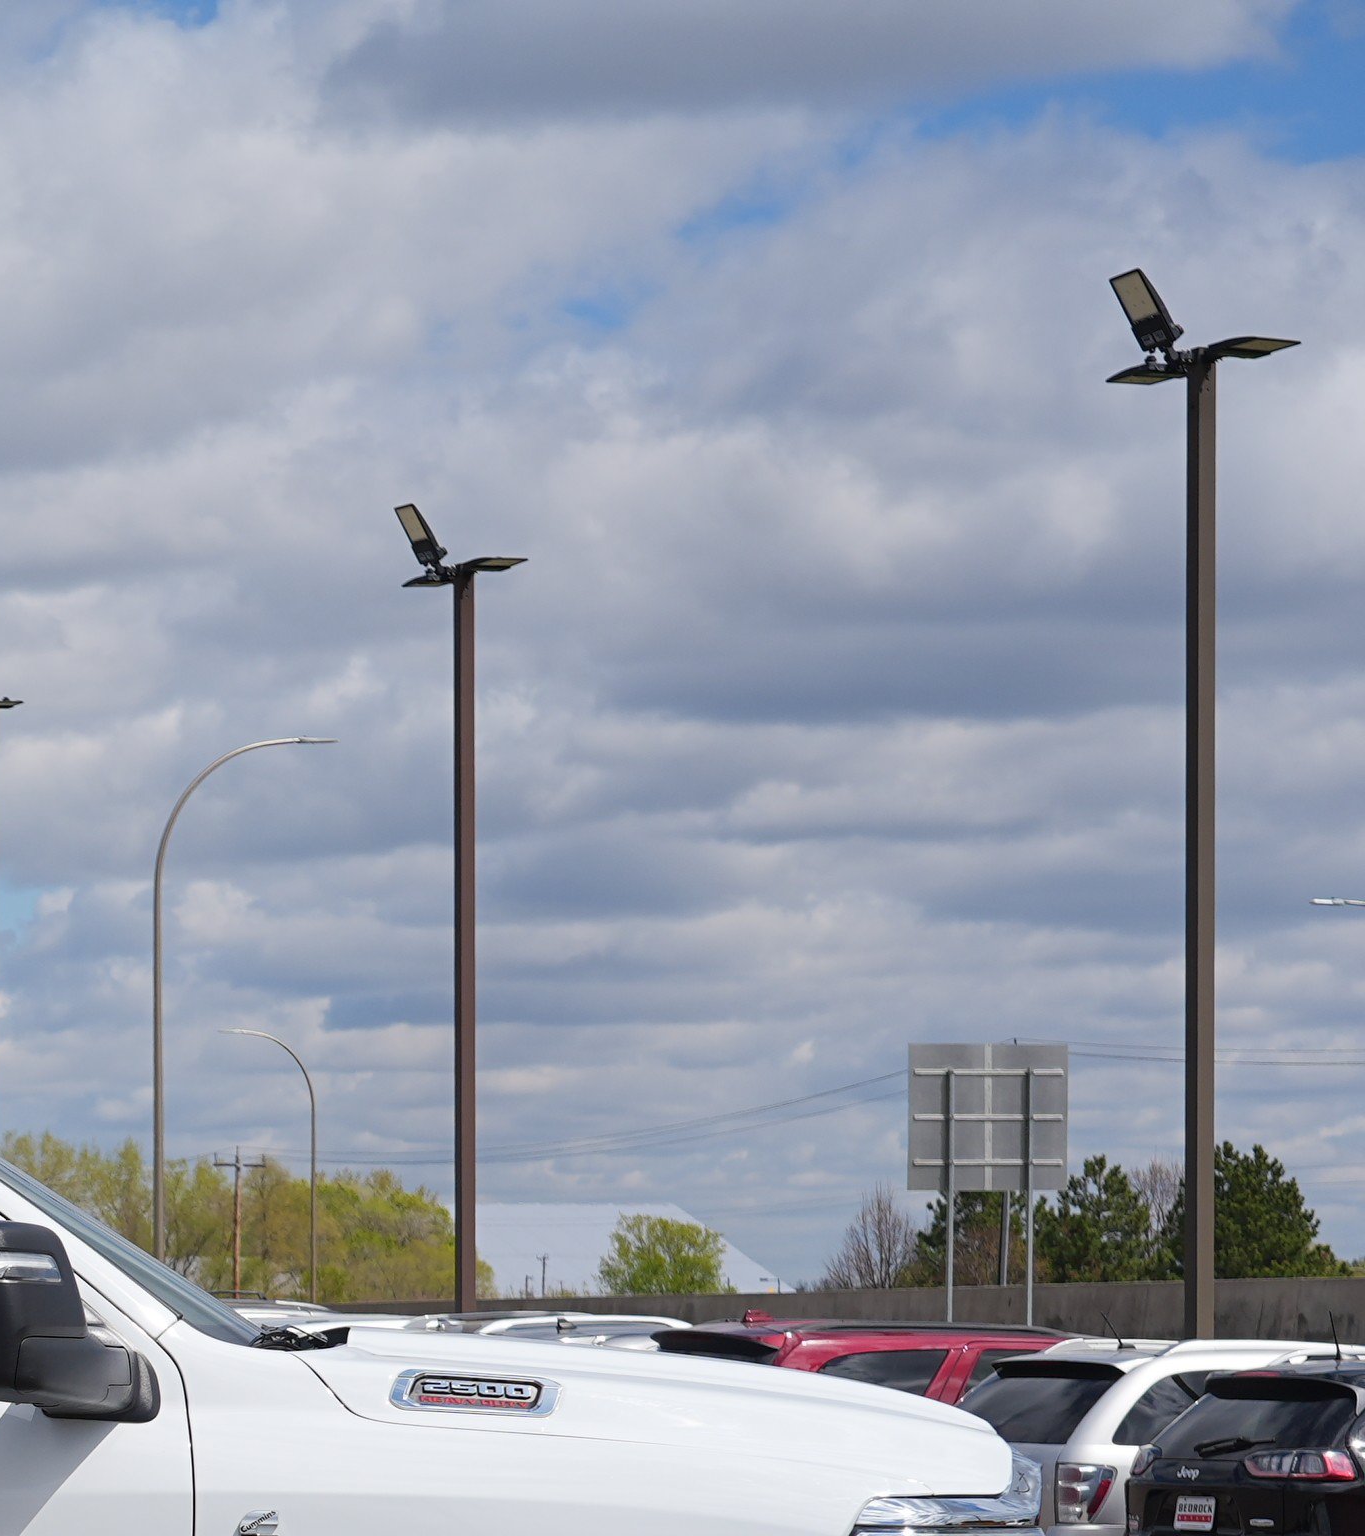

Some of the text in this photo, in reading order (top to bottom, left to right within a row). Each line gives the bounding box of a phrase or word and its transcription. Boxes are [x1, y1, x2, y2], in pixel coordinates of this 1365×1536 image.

[420, 1379, 532, 1399] 2500
[1176, 1466, 1200, 1481] Jeep
[1178, 1503, 1213, 1513] BEDROCK
[240, 1510, 276, 1533] Cummins
